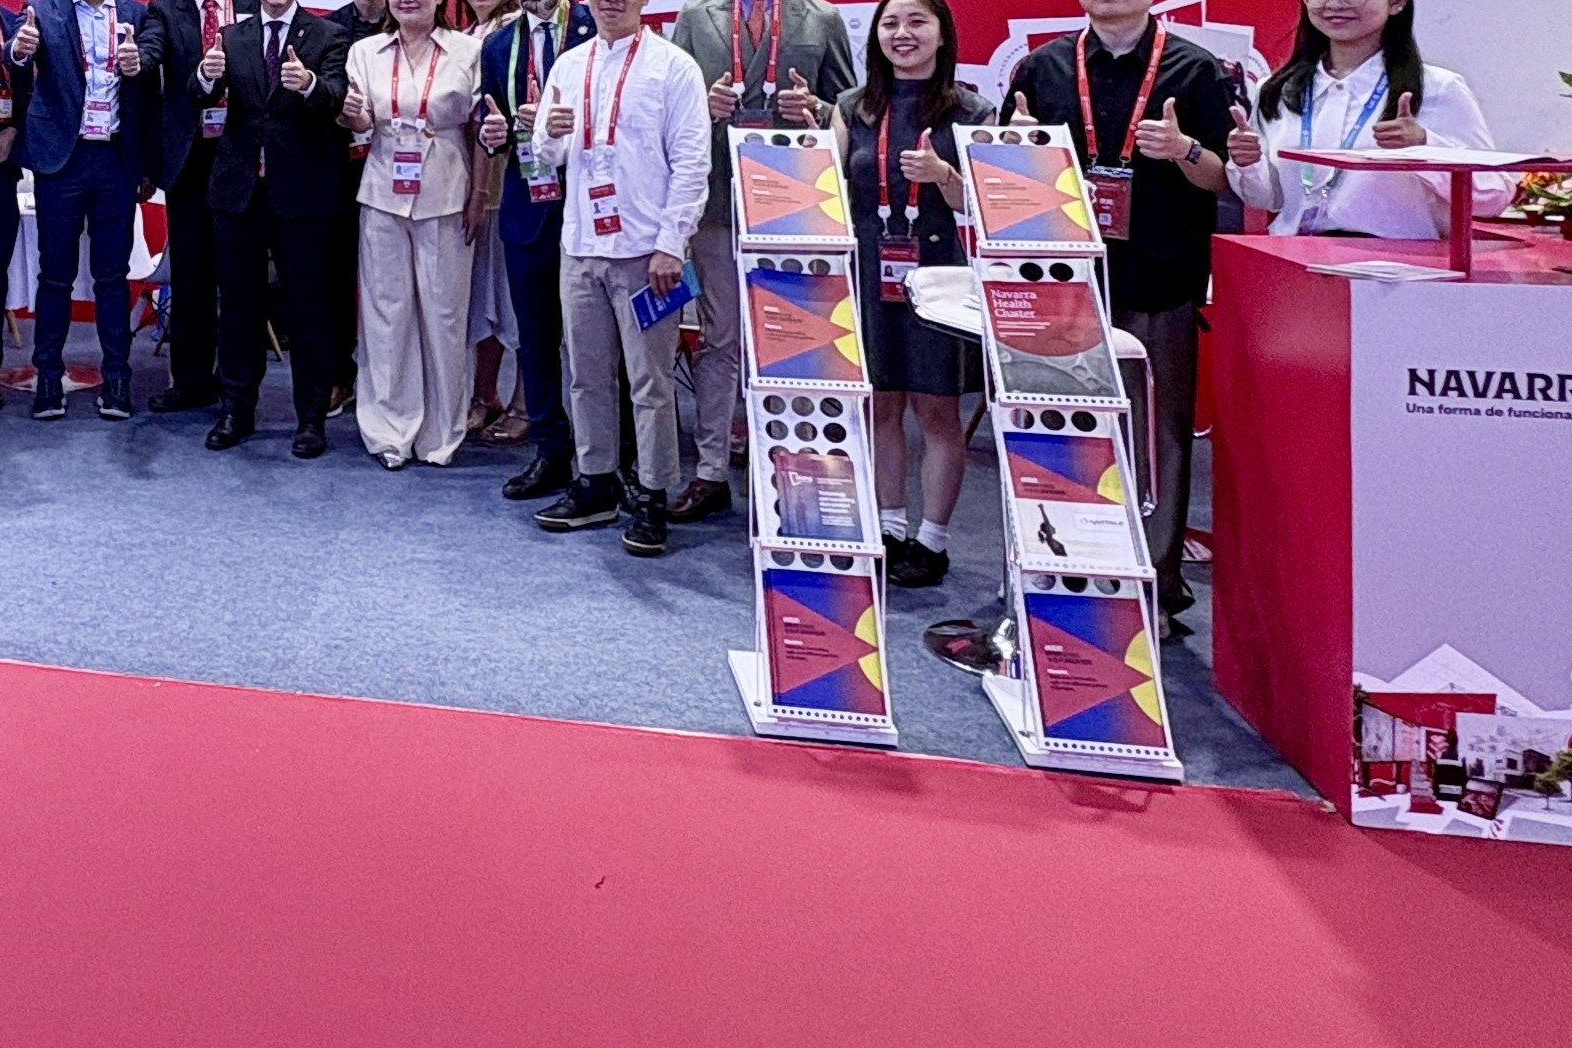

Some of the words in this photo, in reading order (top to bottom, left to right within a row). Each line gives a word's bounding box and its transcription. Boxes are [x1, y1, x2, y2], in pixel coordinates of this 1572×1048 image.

[990, 288, 1038, 300] Navarra
[992, 299, 1033, 311] Health
[993, 308, 1036, 319] Cluster
[1405, 402, 1435, 415] Una
[1438, 403, 1482, 416] forma
[1484, 406, 1504, 418] de
